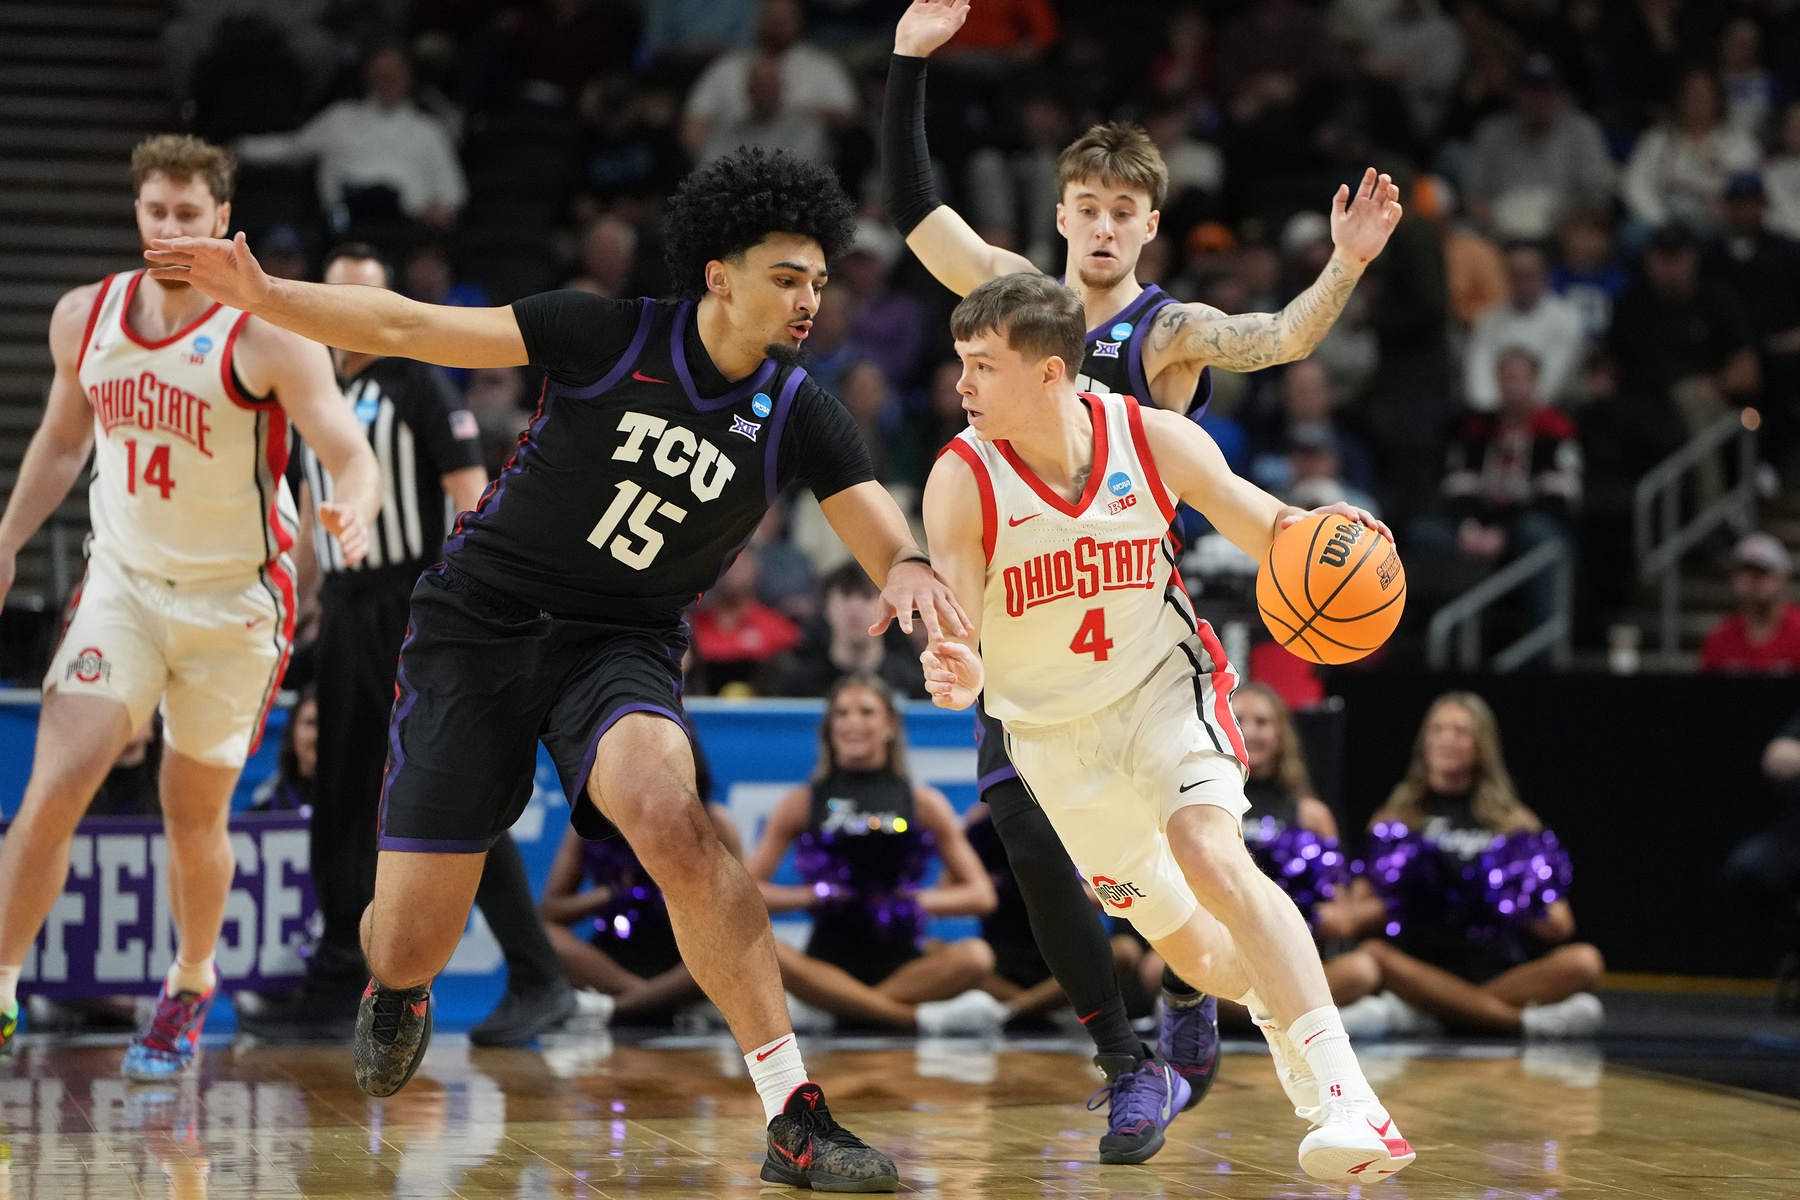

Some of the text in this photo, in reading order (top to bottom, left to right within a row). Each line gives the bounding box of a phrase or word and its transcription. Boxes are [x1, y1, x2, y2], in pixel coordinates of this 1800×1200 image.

[732, 416, 758, 439] XII
[124, 439, 176, 499] 14
[611, 411, 737, 503] TCU
[586, 479, 688, 571] 15
[1318, 519, 1366, 569] Wils
[1069, 607, 1114, 662] 4
